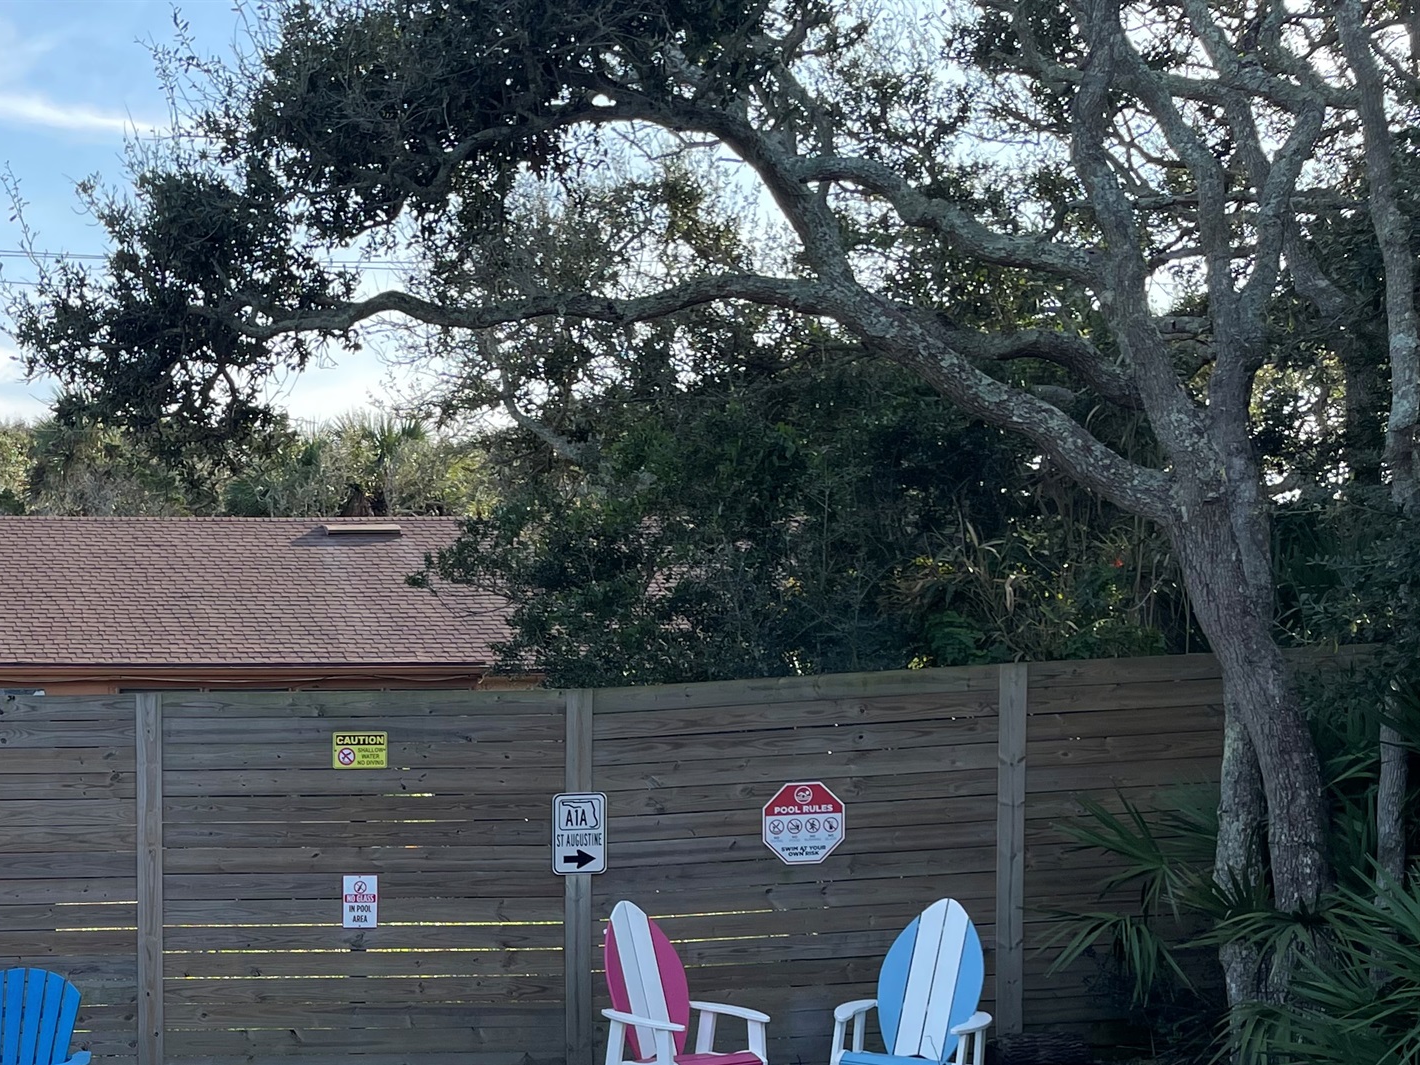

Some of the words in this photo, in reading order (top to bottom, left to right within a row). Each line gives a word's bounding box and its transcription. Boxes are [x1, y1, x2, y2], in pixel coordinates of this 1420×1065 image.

[336, 736, 384, 744] CAUTION
[774, 806, 801, 814] POOL
[802, 804, 834, 813] RULES
[565, 809, 588, 826] A1A
[556, 834, 564, 847] ST
[566, 832, 603, 847] AUGUSTINE
